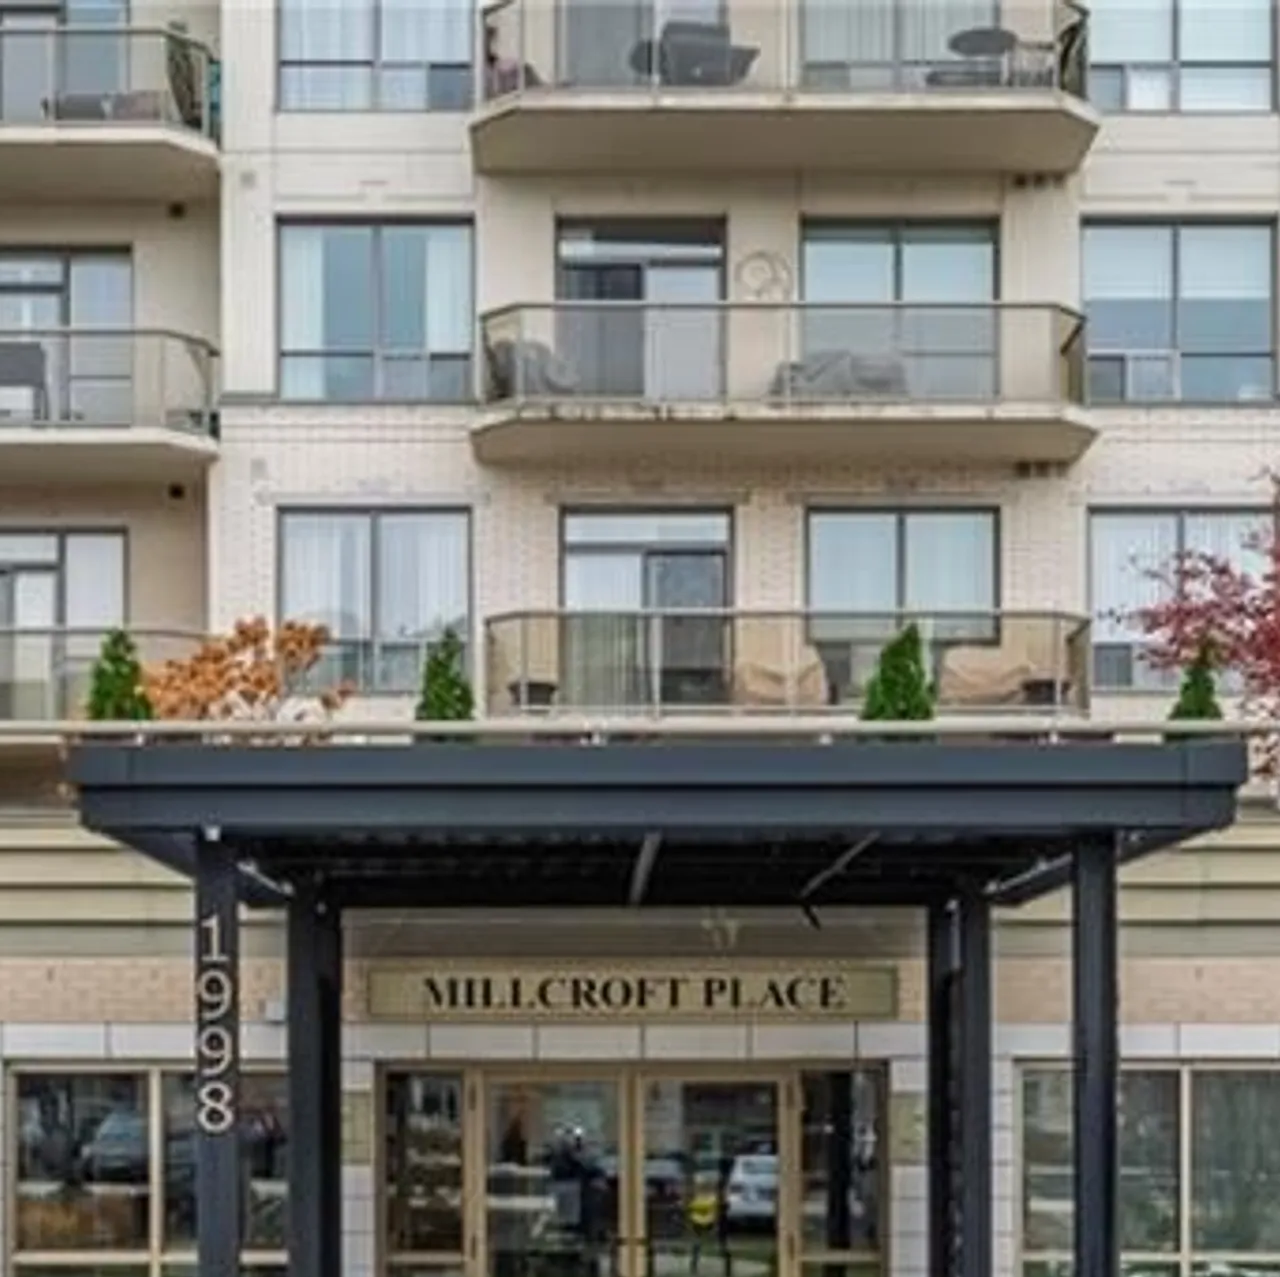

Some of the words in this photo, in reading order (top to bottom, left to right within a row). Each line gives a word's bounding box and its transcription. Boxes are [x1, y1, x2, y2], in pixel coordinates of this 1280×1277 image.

[198, 915, 233, 1133] 1998
[422, 977, 690, 1009] MILLCROFT
[703, 977, 847, 1009] PLACE
